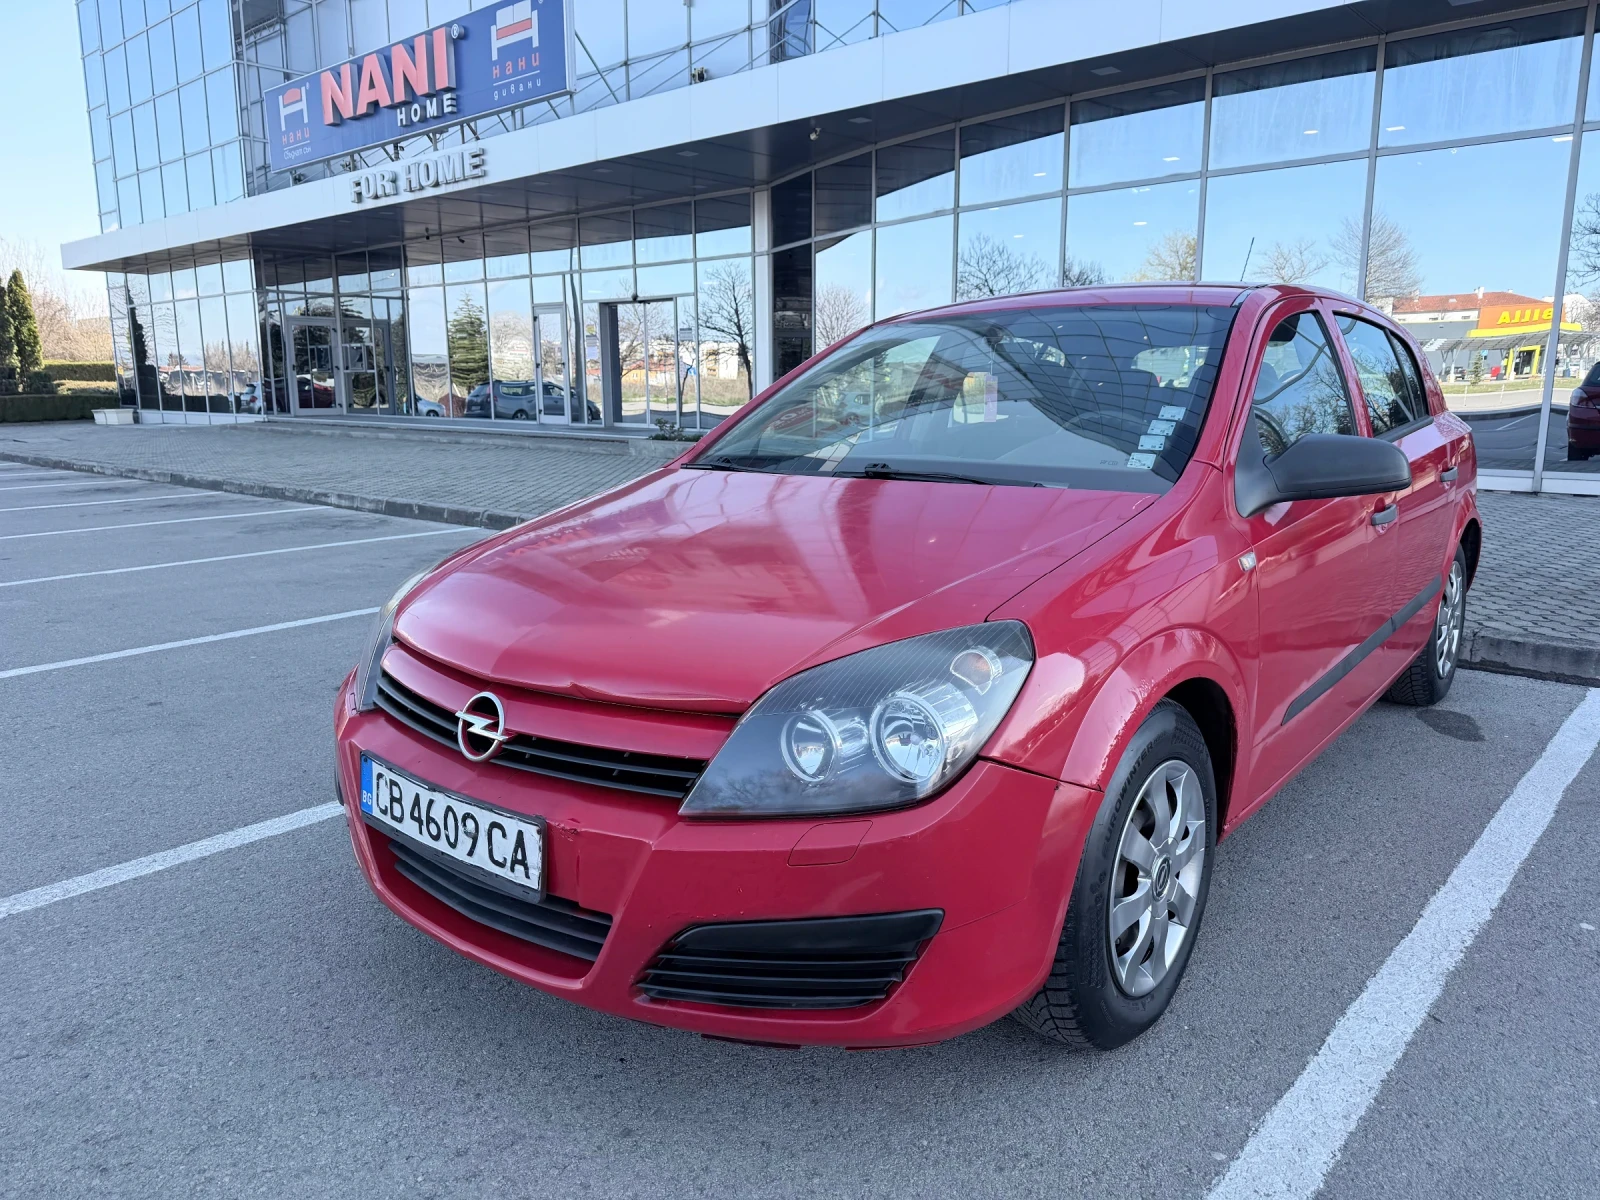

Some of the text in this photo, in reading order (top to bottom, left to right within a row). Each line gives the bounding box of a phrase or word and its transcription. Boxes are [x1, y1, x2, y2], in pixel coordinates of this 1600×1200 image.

[320, 27, 456, 126] NANI
[397, 93, 457, 127] HOME
[350, 147, 488, 203] FOR HOME
